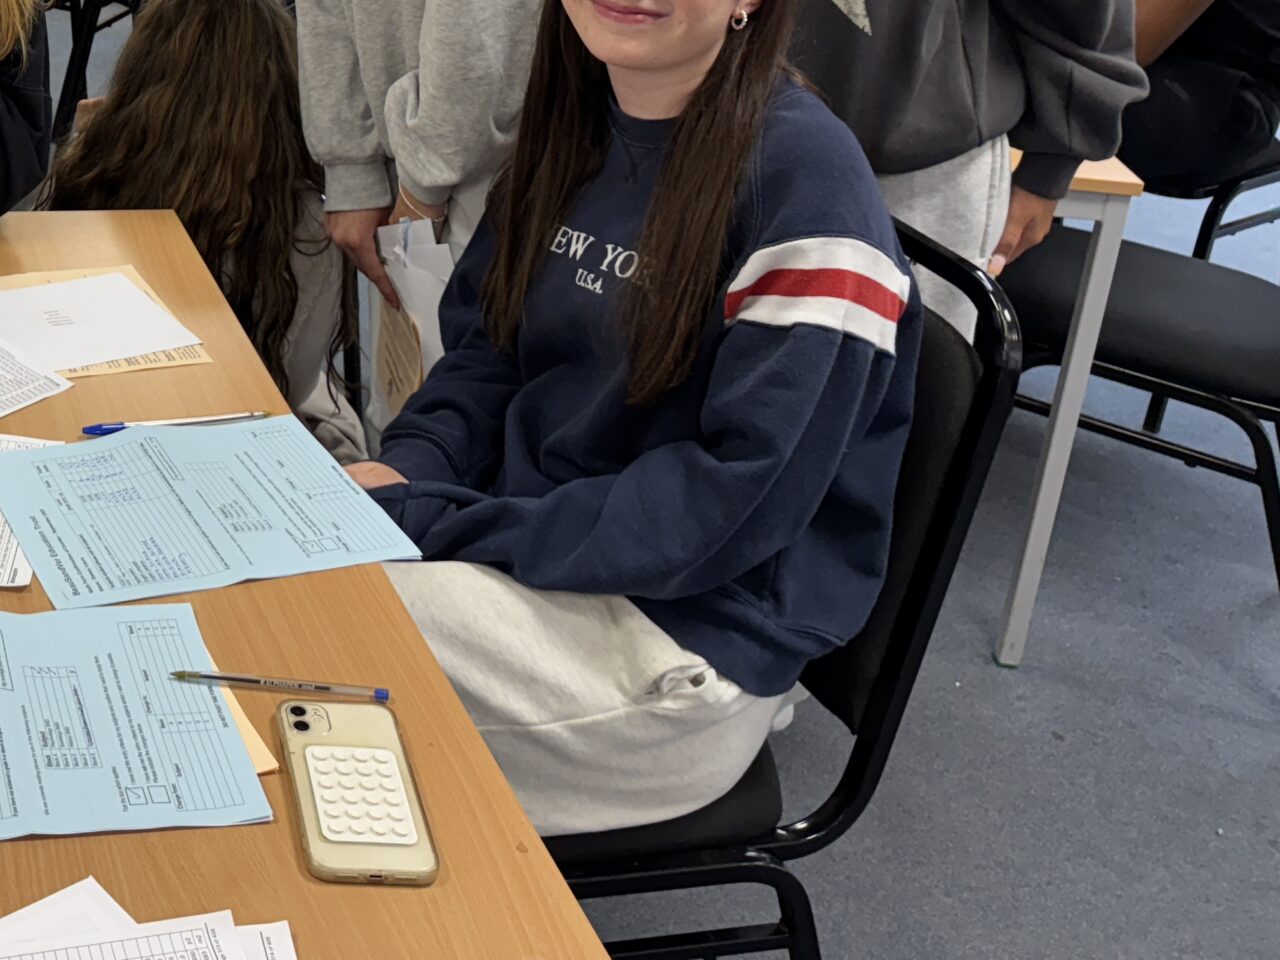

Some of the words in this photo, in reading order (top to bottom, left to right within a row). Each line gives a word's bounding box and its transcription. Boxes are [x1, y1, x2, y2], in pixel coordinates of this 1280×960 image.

[549, 225, 596, 261] EW
[29, 515, 41, 529] Trust
[38, 530, 57, 557] Education
